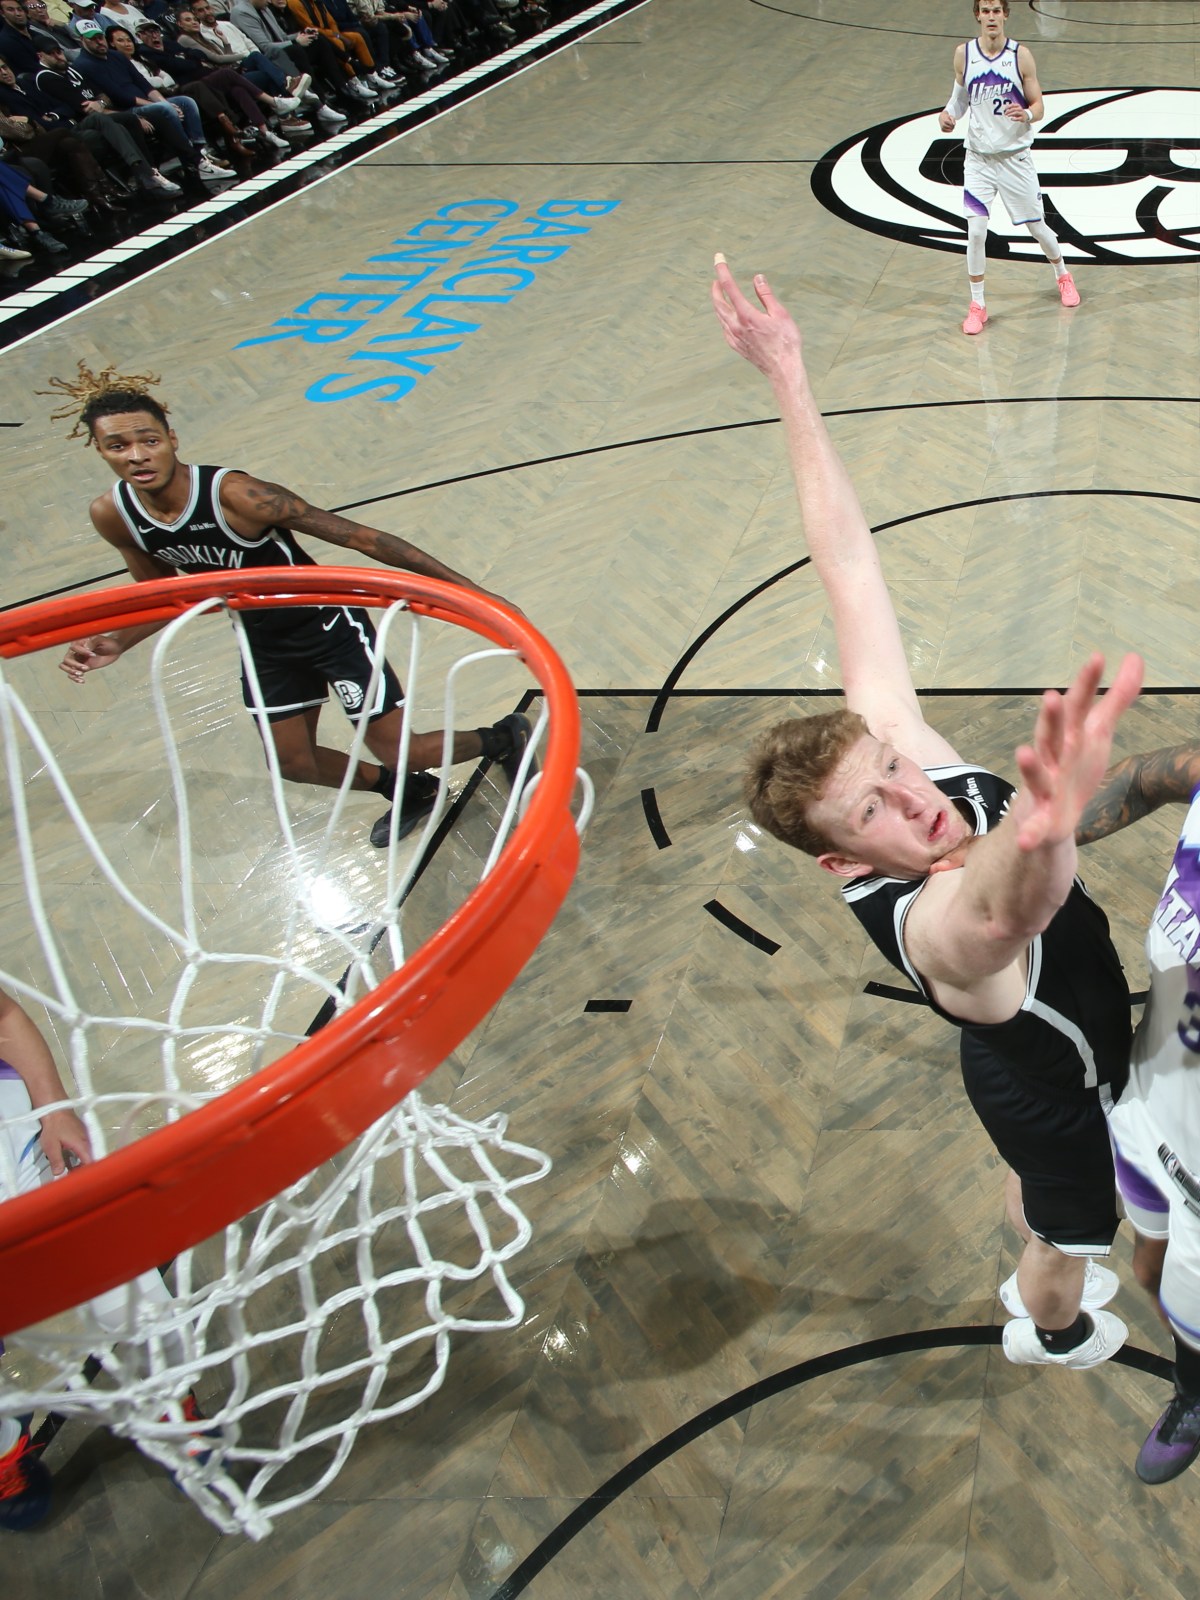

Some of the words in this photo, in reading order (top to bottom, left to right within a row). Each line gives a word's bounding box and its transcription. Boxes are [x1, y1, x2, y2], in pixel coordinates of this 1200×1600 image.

[971, 82, 1014, 107] UTAH
[231, 198, 520, 350] CENTER
[304, 199, 623, 403] BARCLAYS
